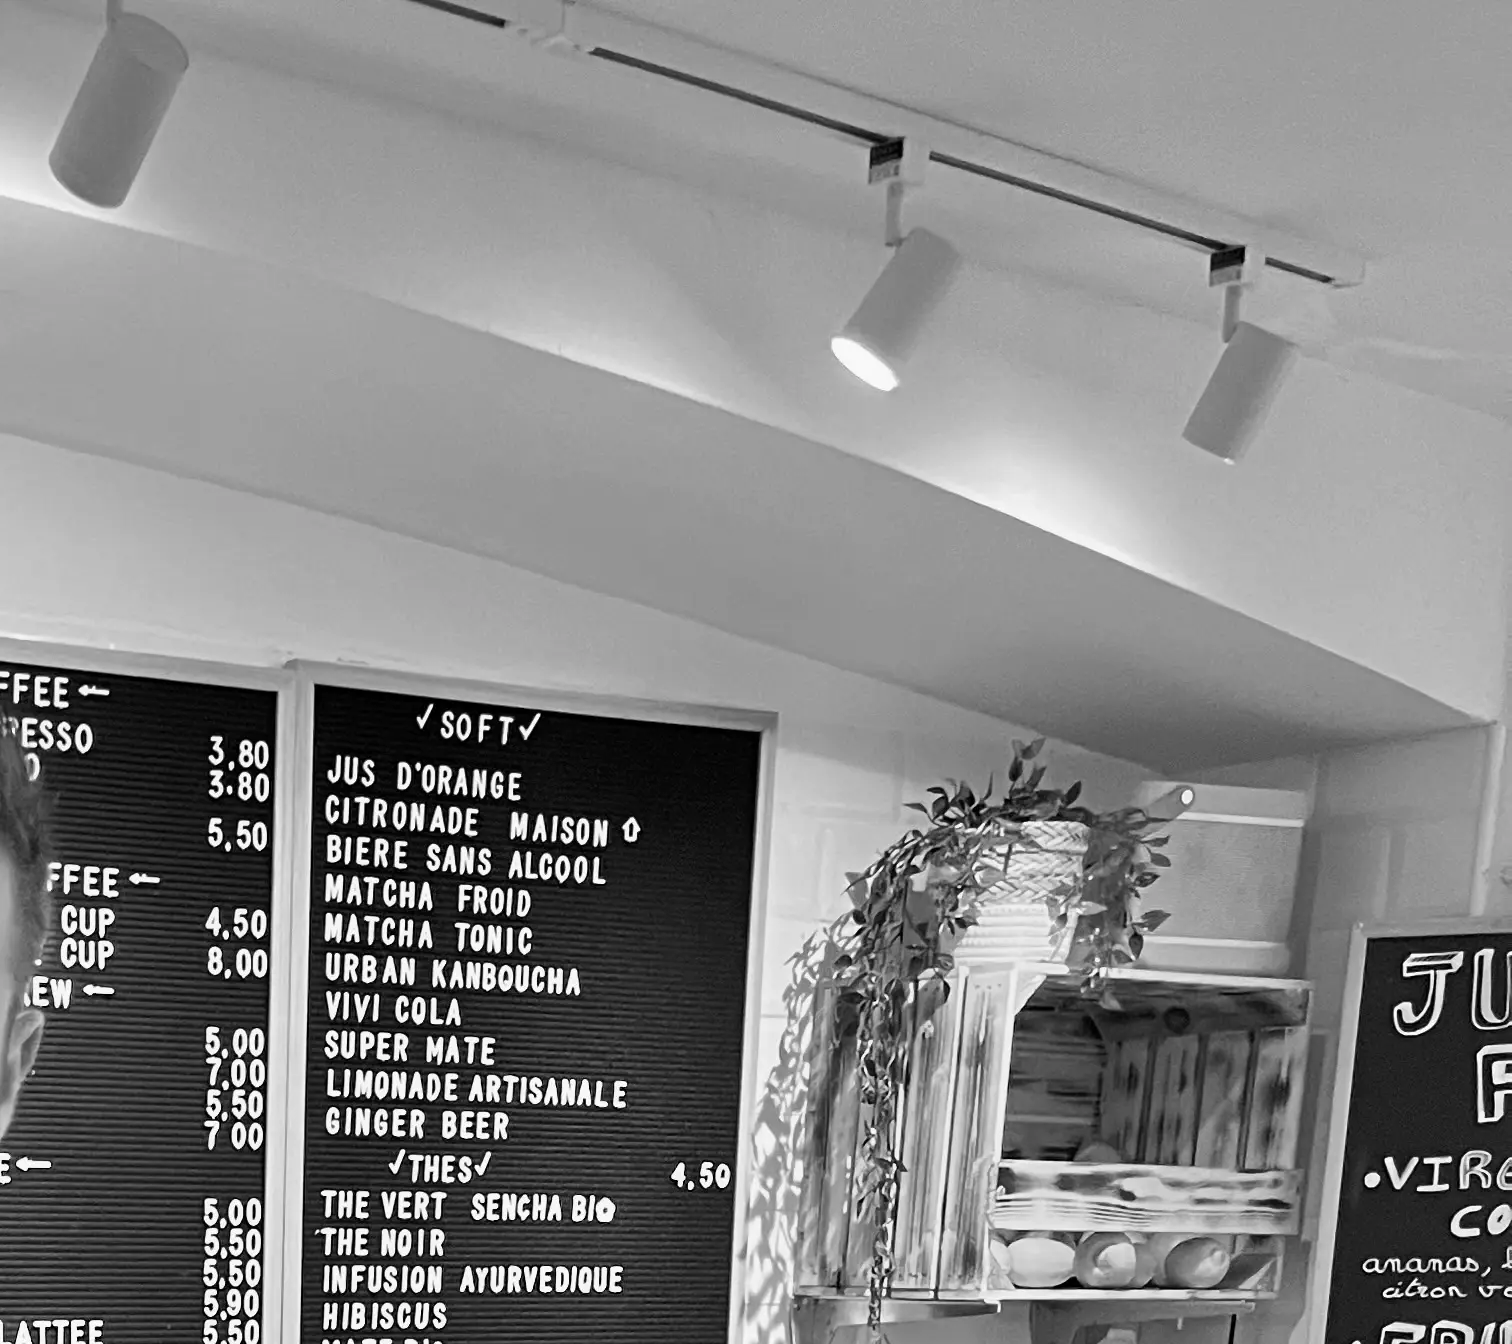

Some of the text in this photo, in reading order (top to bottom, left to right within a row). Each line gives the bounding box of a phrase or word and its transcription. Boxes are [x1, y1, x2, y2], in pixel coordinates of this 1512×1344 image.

[441, 711, 513, 744] SOFT
[328, 755, 521, 801] JUS D'ORANGE
[326, 795, 608, 847] CITRONADE MAISON
[327, 835, 606, 884] BIERE SANS ALCOOL
[325, 874, 530, 917] MATCHA FROID
[61, 905, 115, 938] CUP
[325, 913, 532, 955] MATCHA TONIC
[61, 938, 114, 969] CUP
[326, 953, 415, 985] URBAN
[326, 991, 461, 1025] VIVI COLA
[325, 1030, 495, 1065] SUPER MATE
[327, 1069, 627, 1108] LIMONADE ARTISANALE
[326, 1107, 509, 1140] GINGER BEER
[408, 1155, 472, 1183] THES
[321, 1190, 615, 1222] THE VERT SENCHA BIO
[320, 1227, 444, 1257] THE NOIR
[324, 1265, 623, 1293] INFUSION AYURVEDIQUE
[1382, 1277, 1468, 1299] citron
[323, 1303, 447, 1330] HIBISCUS
